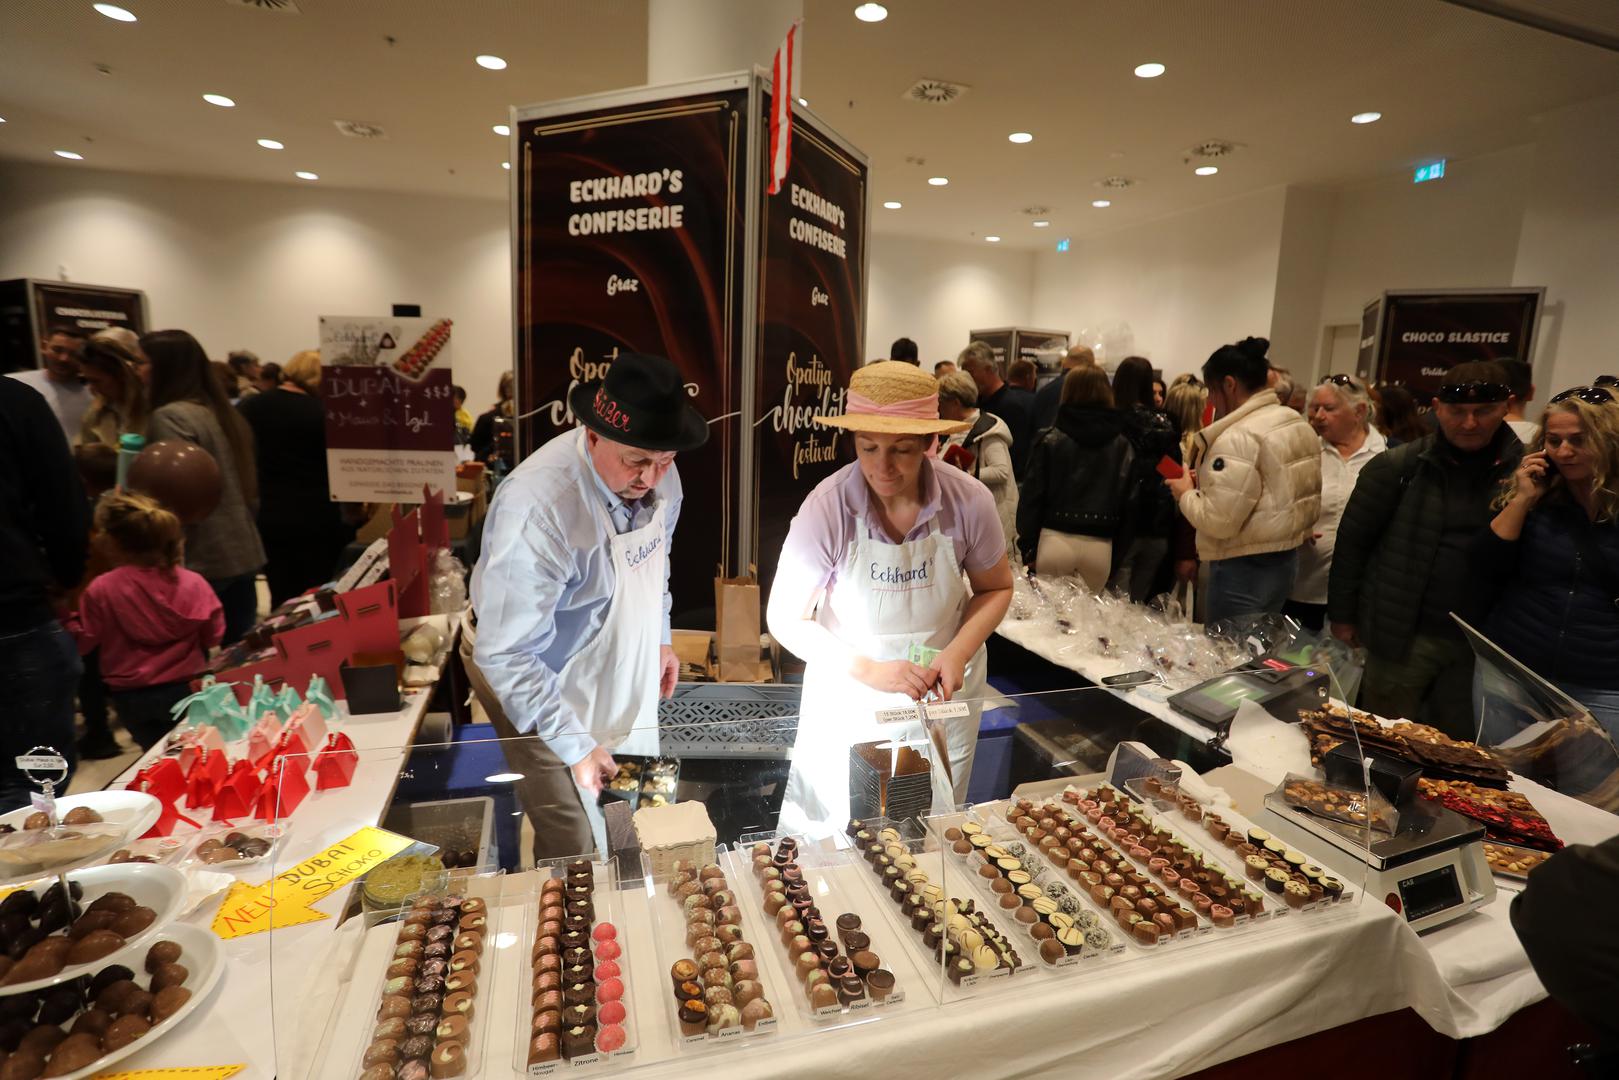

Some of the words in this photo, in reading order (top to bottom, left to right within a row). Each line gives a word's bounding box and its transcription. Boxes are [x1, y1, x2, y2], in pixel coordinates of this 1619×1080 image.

[569, 168, 684, 203] ECKHARD'S
[568, 204, 684, 236] CONFISERIE
[791, 183, 845, 230] ECKHARD'S
[789, 217, 846, 259] CONFISERIE
[606, 274, 639, 296] Graz
[811, 286, 829, 306] Graz
[1402, 332, 1444, 343] CHOCO
[1448, 332, 1510, 343] SLASTICE
[786, 351, 832, 399] Opatija
[793, 431, 838, 480] festival
[277, 844, 355, 886] DUBAI
[223, 895, 278, 933] NEU
[720, 1030, 741, 1038] Ananas
[574, 1057, 599, 1067] Zitrone
